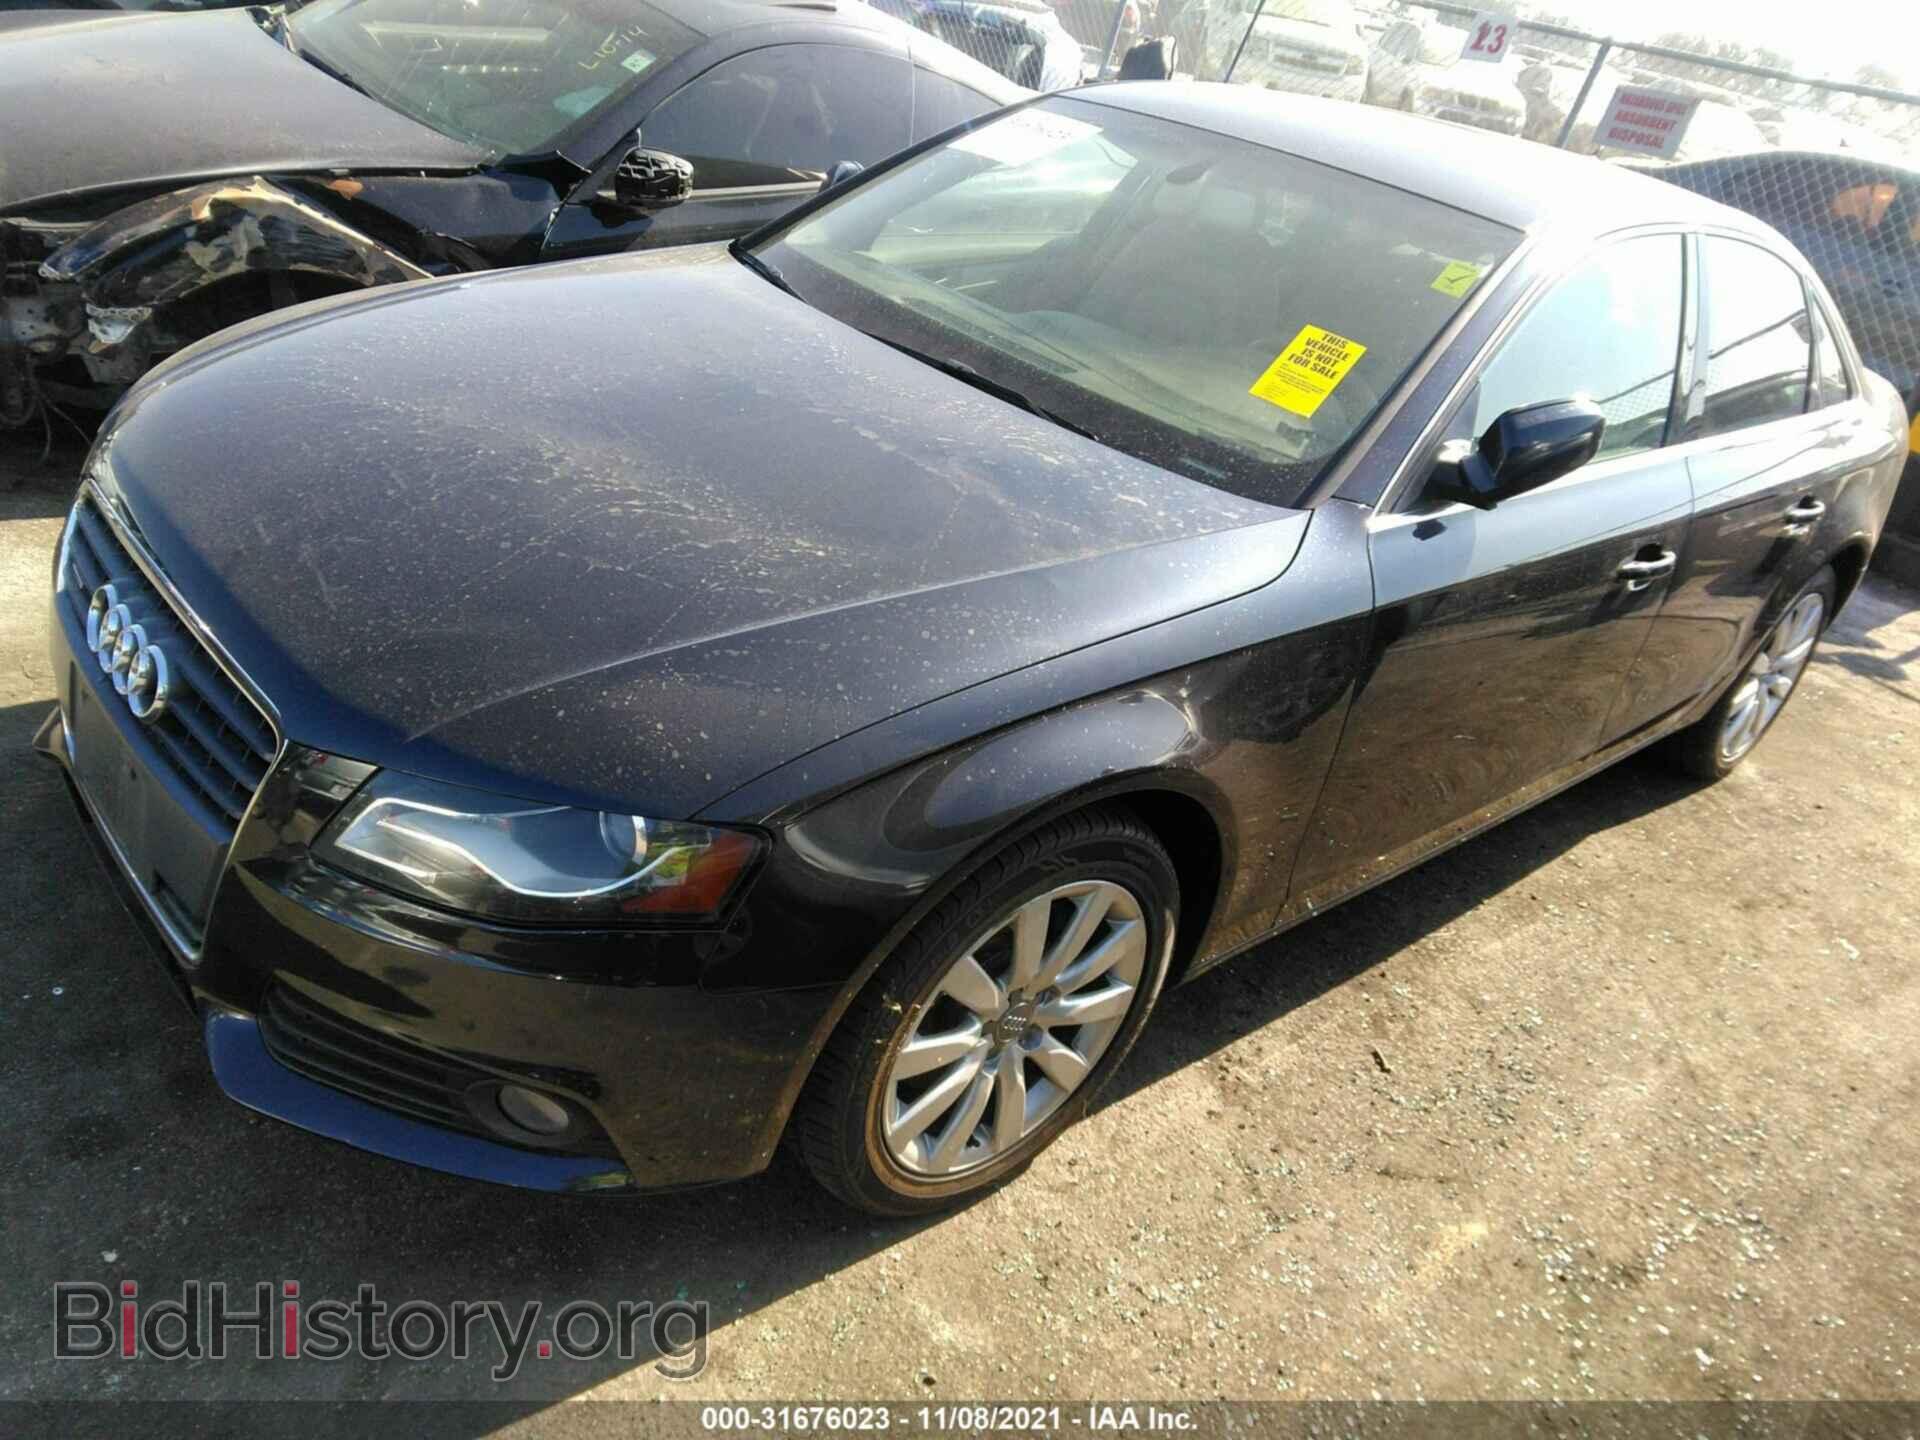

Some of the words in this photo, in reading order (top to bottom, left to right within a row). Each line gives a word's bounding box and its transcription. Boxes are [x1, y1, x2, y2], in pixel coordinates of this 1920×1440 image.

[1306, 338, 1350, 361] VEHICLE
[1322, 334, 1348, 348] THIS
[1288, 354, 1311, 367] FOR
[1311, 362, 1338, 379] SALE
[1302, 348, 1313, 358] IS
[1316, 354, 1338, 367] NOT
